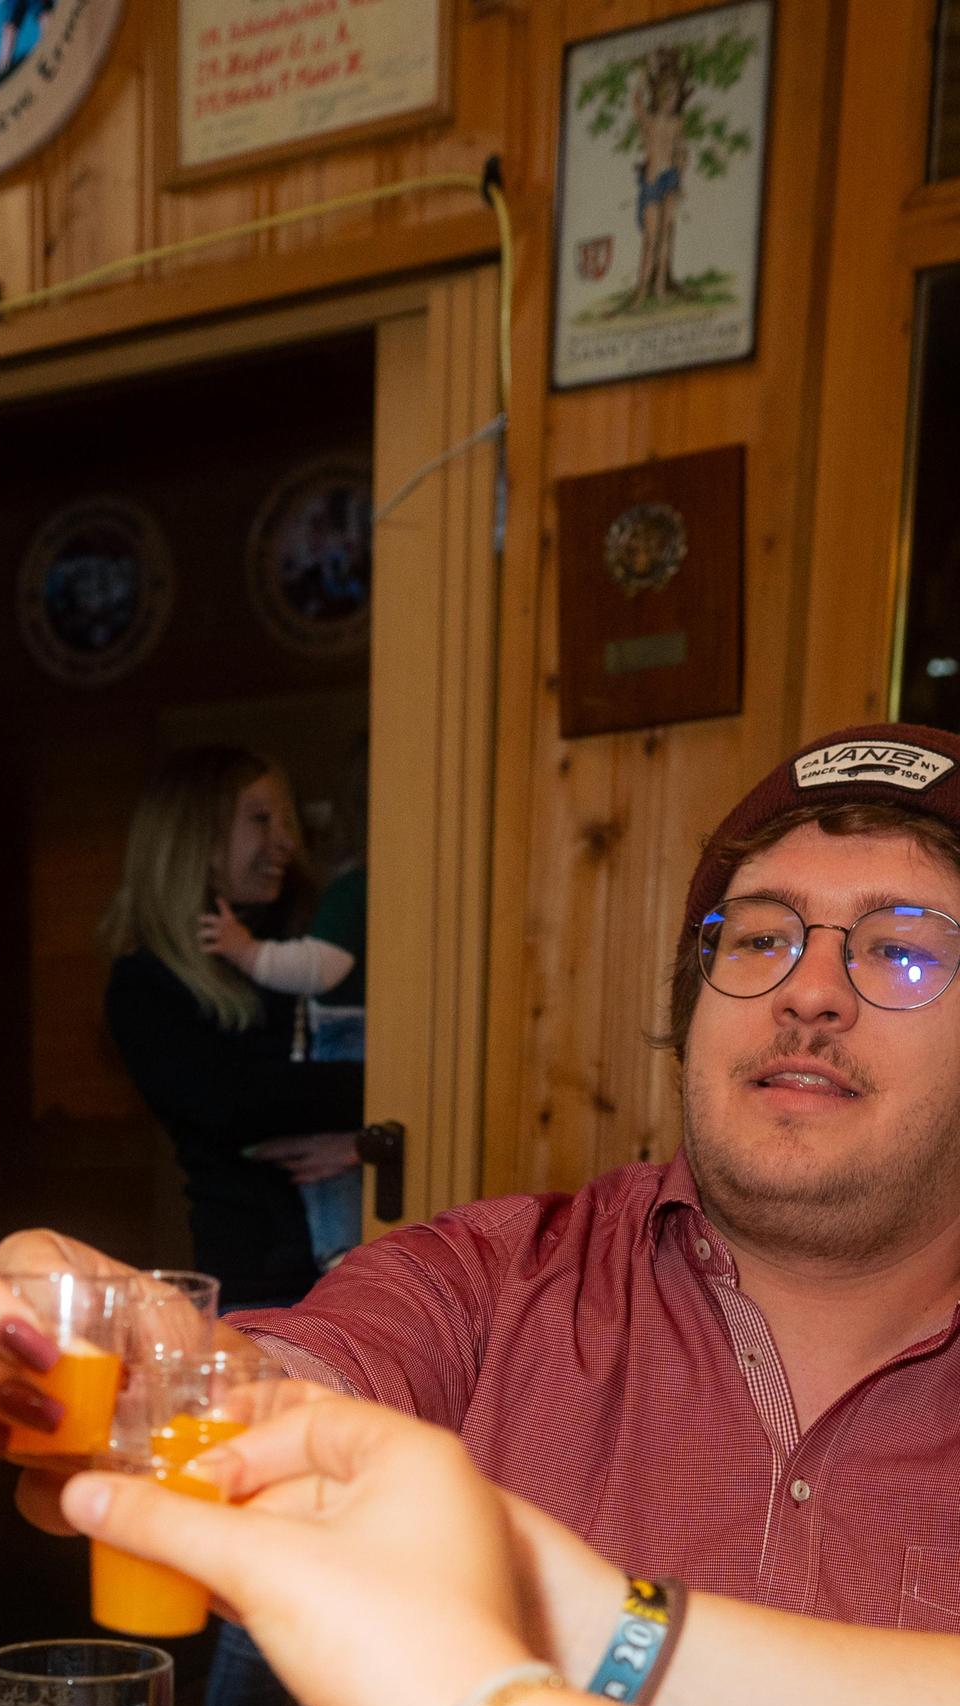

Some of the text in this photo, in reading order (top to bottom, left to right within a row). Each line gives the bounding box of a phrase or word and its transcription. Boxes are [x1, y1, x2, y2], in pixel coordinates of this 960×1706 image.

[802, 745, 940, 773] CA VANS NY
[800, 766, 927, 783] SINCE 1966
